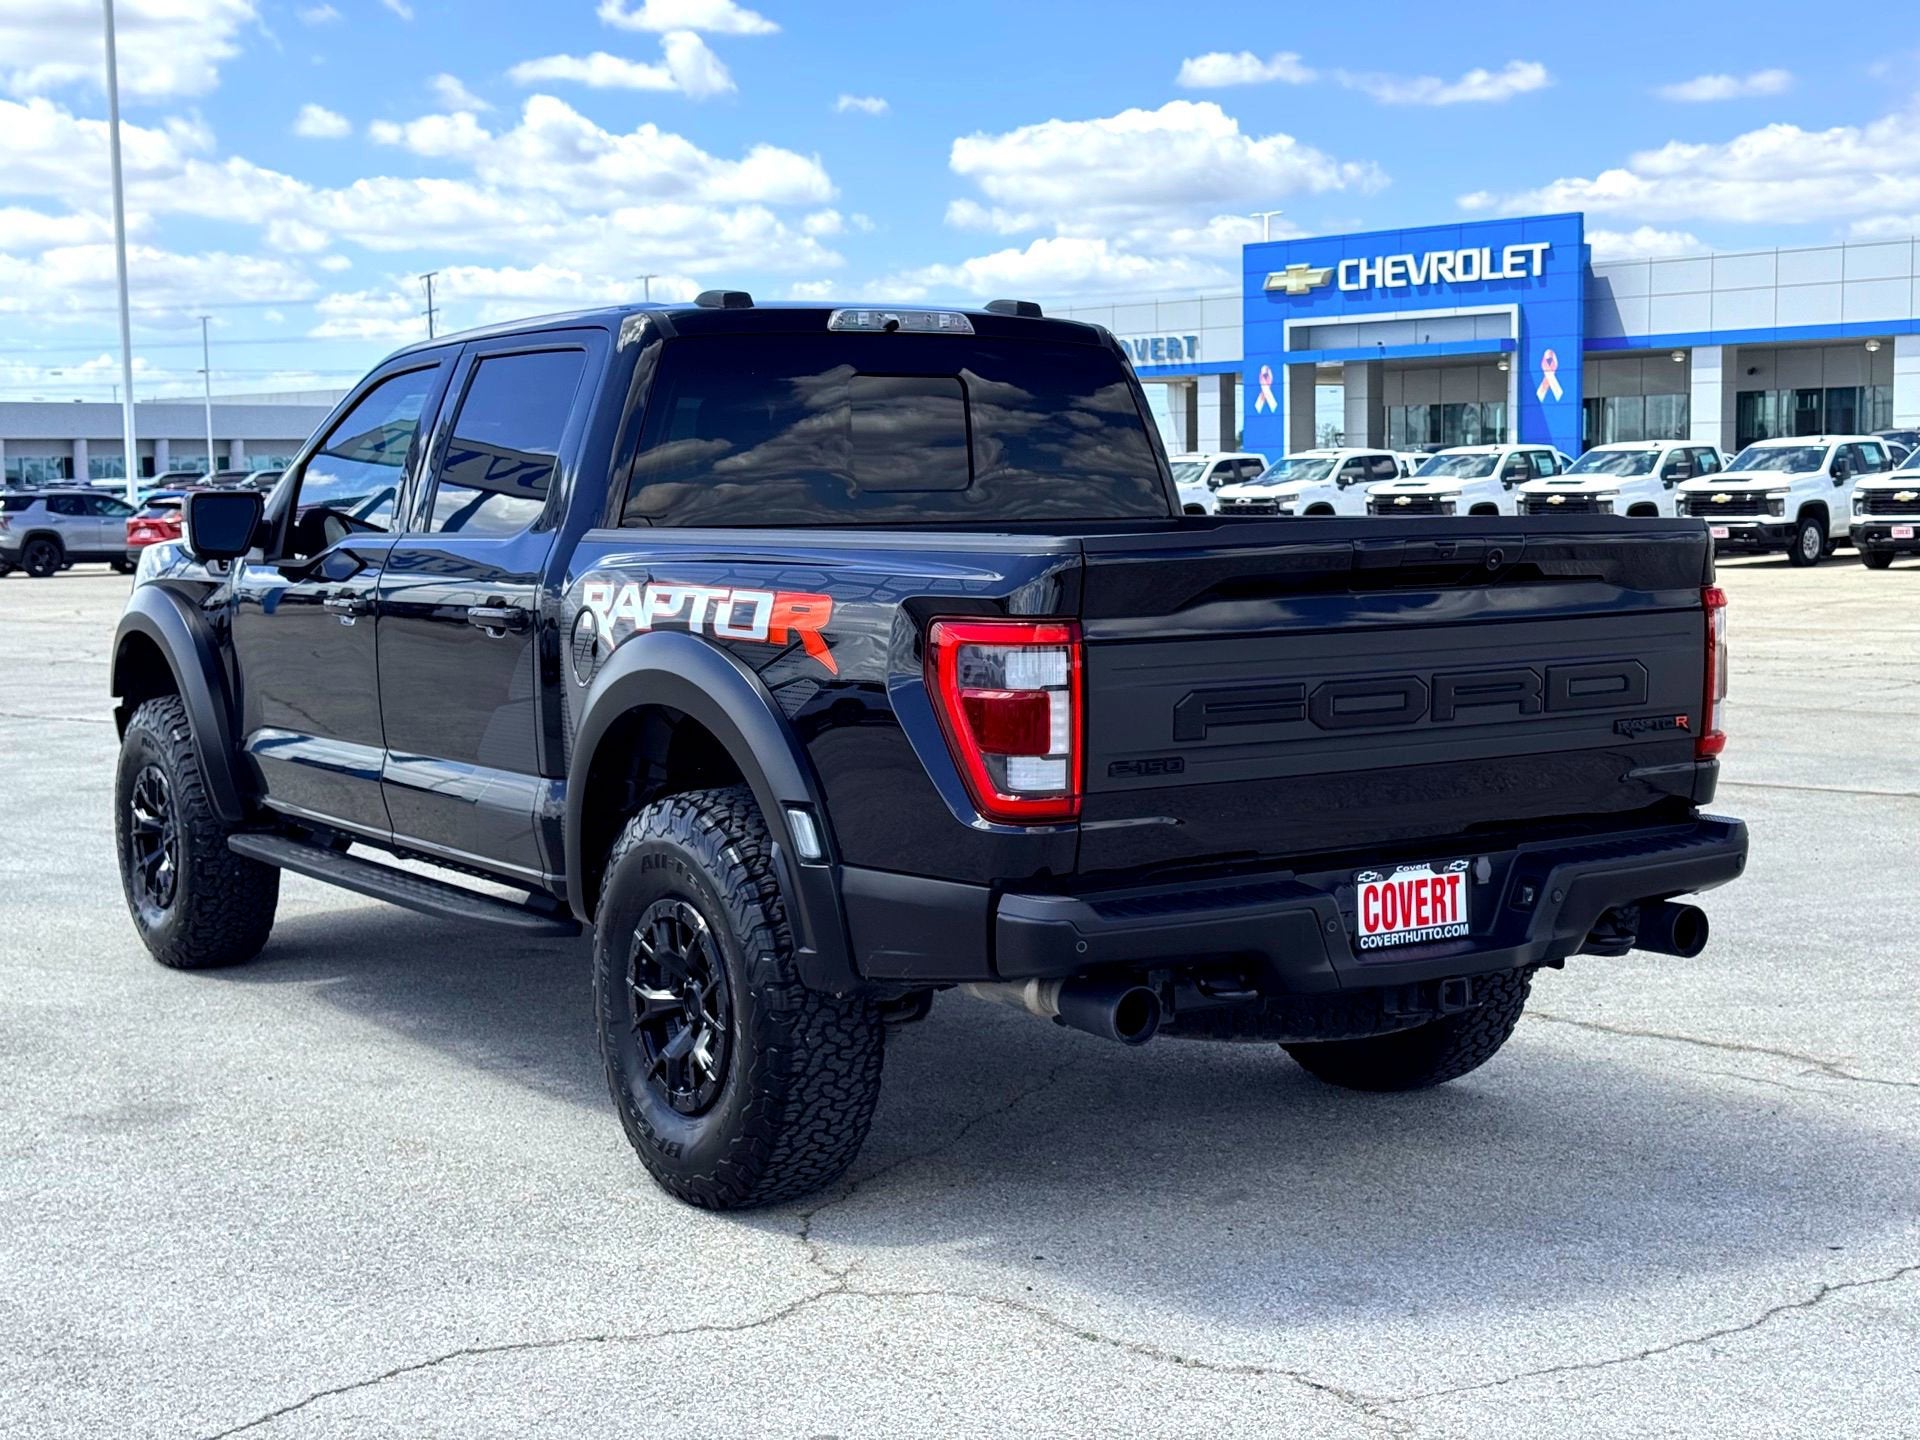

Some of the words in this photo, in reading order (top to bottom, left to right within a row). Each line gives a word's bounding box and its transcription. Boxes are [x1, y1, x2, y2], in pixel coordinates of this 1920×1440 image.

[1338, 242, 1550, 291] CHEVROLET
[583, 582, 838, 675] RAPTOR
[1173, 660, 1648, 741] FORD
[1396, 863, 1430, 872] Covert
[1363, 875, 1460, 933] COVERT
[1360, 924, 1469, 949] COVERTHUTTO.COM
